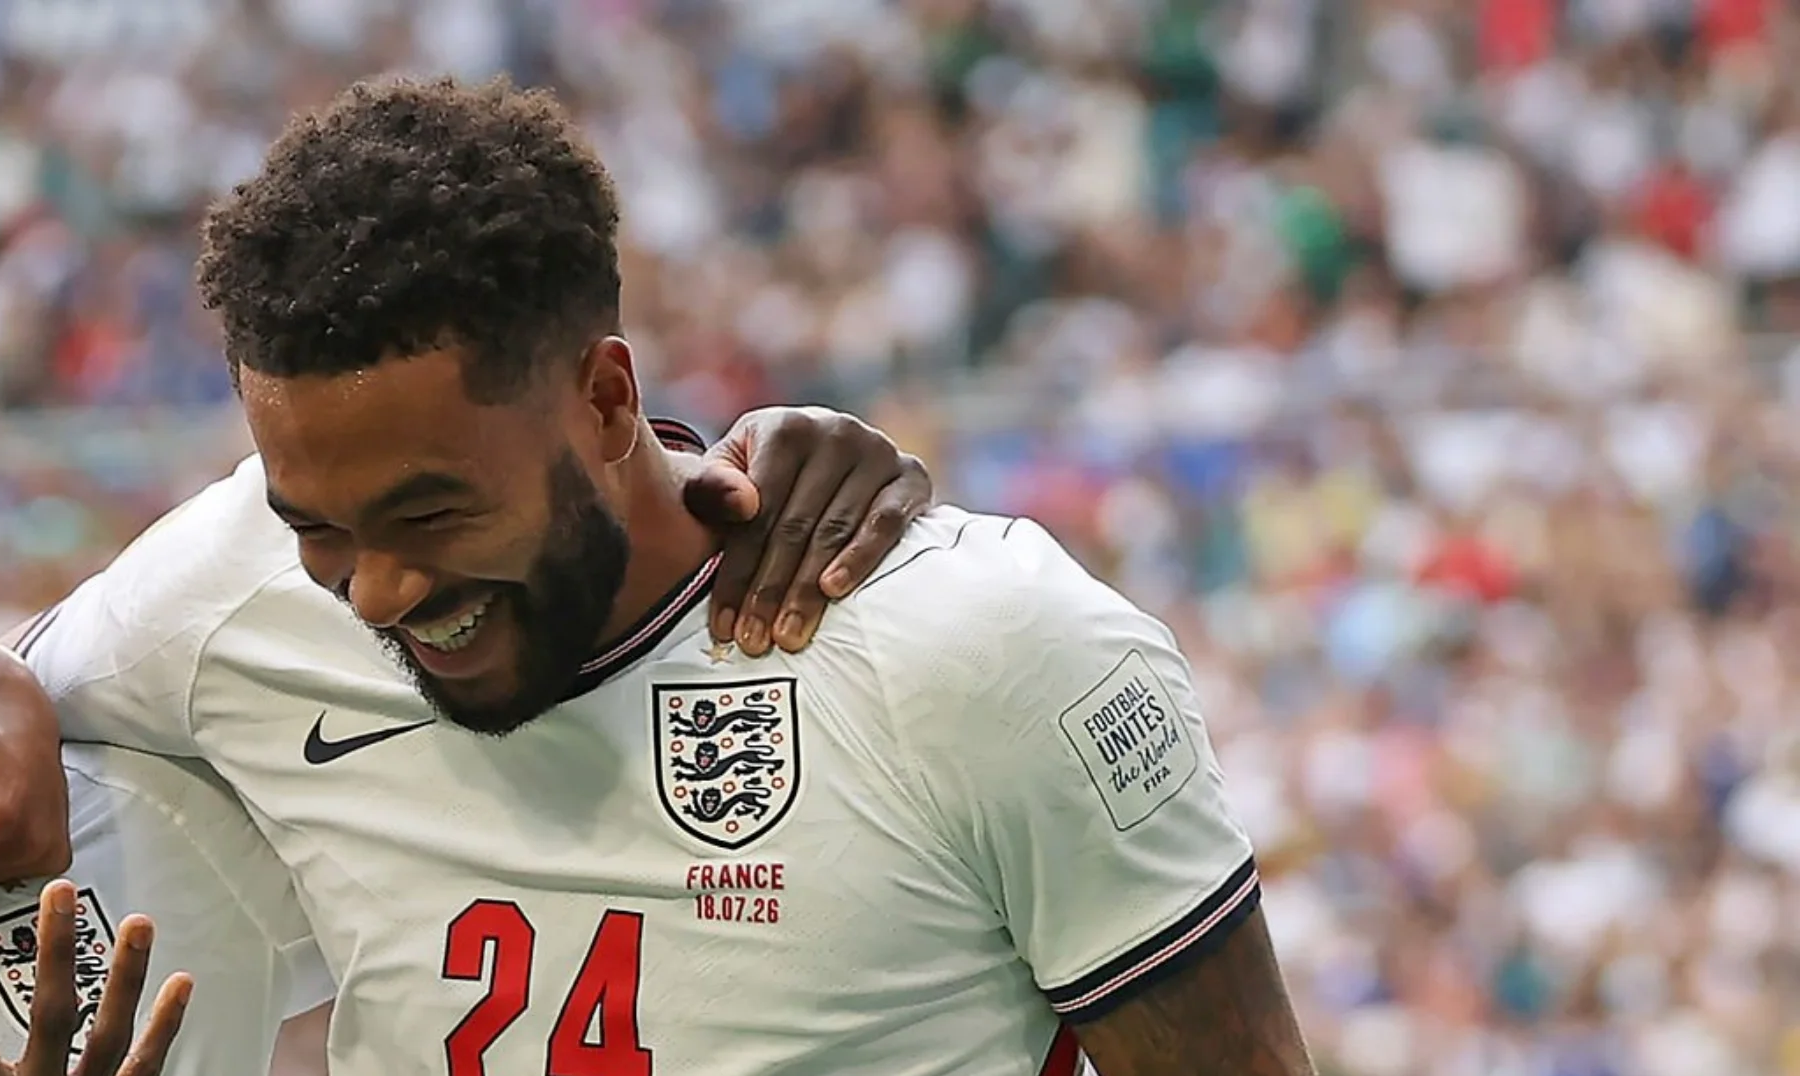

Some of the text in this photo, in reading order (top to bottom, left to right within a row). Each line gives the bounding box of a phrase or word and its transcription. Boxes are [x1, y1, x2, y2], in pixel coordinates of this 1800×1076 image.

[1083, 676, 1149, 740] FOOTBALL
[1096, 695, 1165, 765] UNITES
[1108, 718, 1181, 793] the World
[1142, 765, 1171, 793] FIFA
[686, 863, 785, 890] FRANCE
[695, 894, 779, 924] 18.07.26
